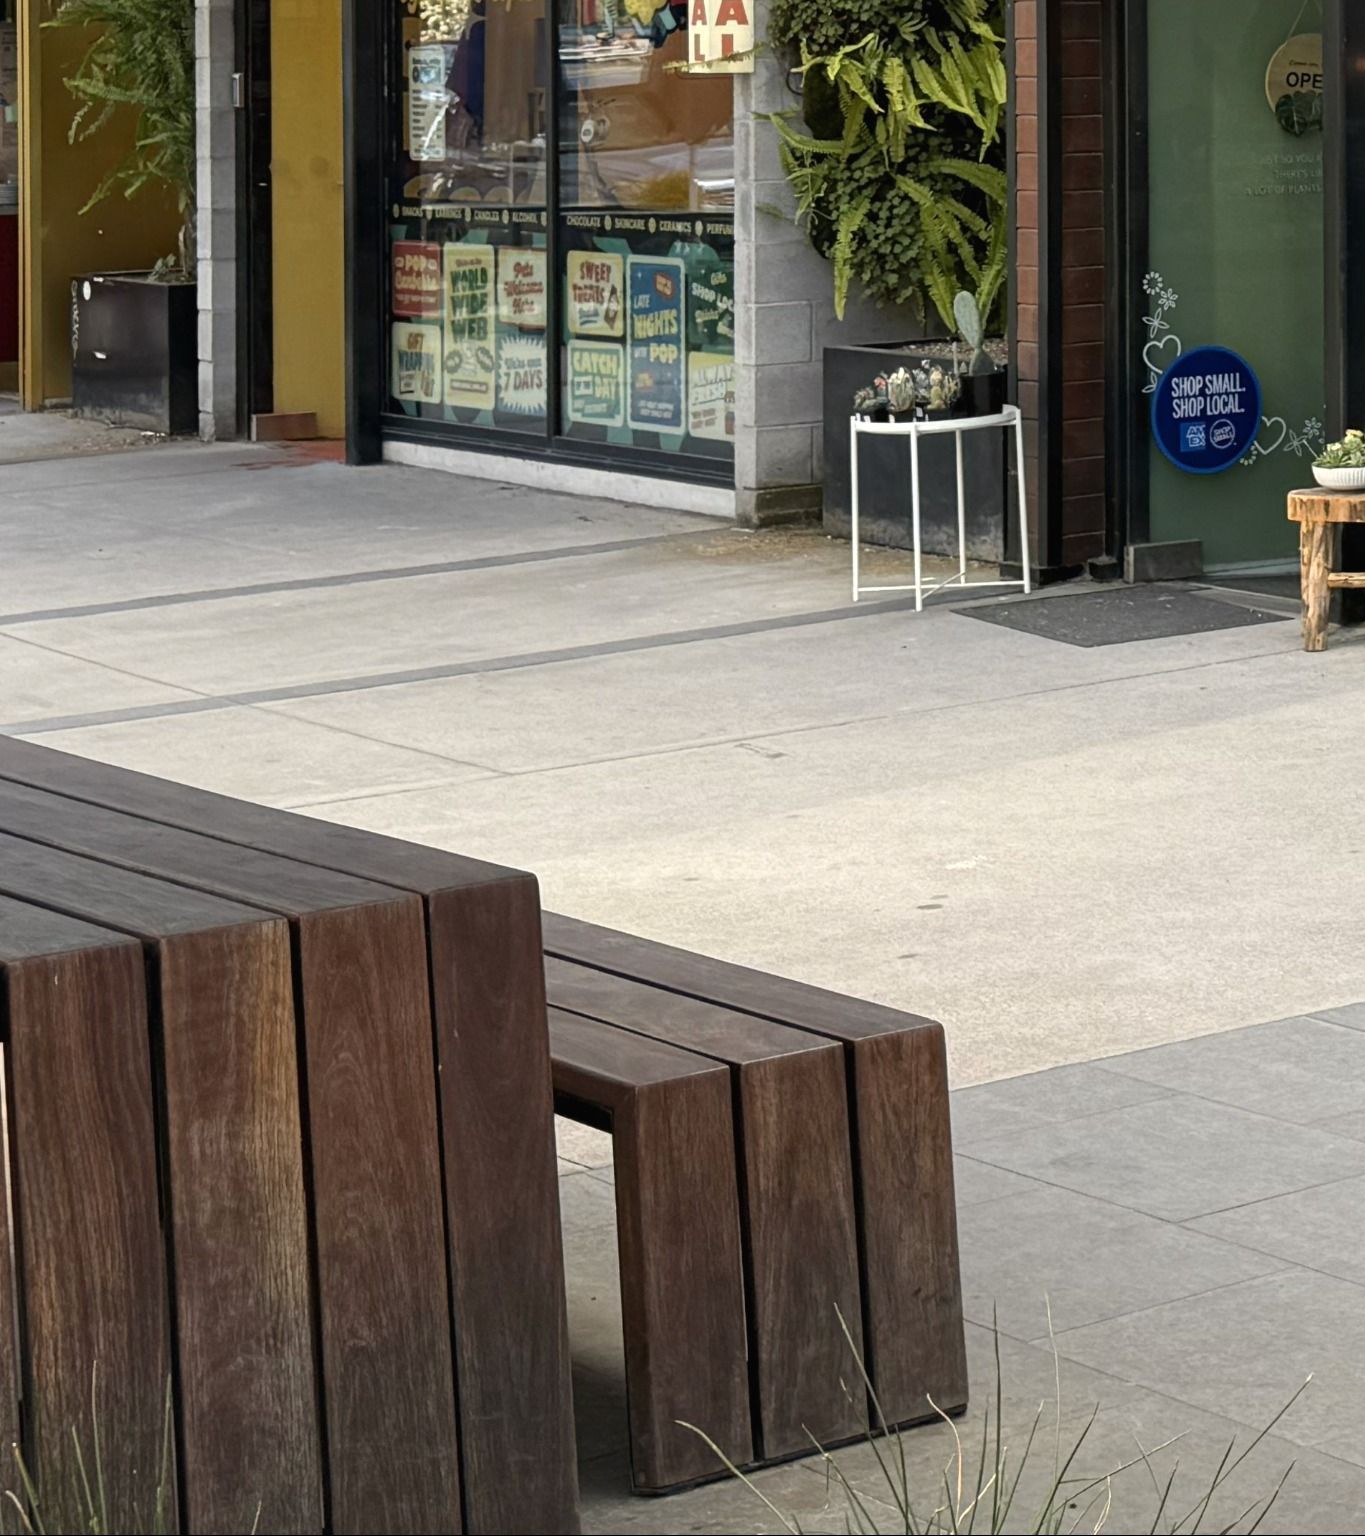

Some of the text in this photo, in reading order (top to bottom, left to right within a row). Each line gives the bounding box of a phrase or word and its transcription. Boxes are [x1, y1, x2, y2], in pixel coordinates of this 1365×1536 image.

[1285, 71, 1324, 90] OPE
[566, 215, 602, 228] CHOCOLATE
[659, 220, 692, 234] CERAMICS
[450, 269, 489, 294] WORLD
[450, 293, 489, 316] WIDE
[451, 317, 489, 344] WEB
[633, 309, 678, 340] NIGHTS
[573, 350, 619, 375] CATCH
[650, 343, 679, 364] POP
[503, 374, 511, 392] 7
[513, 369, 544, 391] DAYS
[1171, 372, 1246, 398] SHOP SMALL.
[1172, 394, 1245, 419] SHOP LOCAL.
